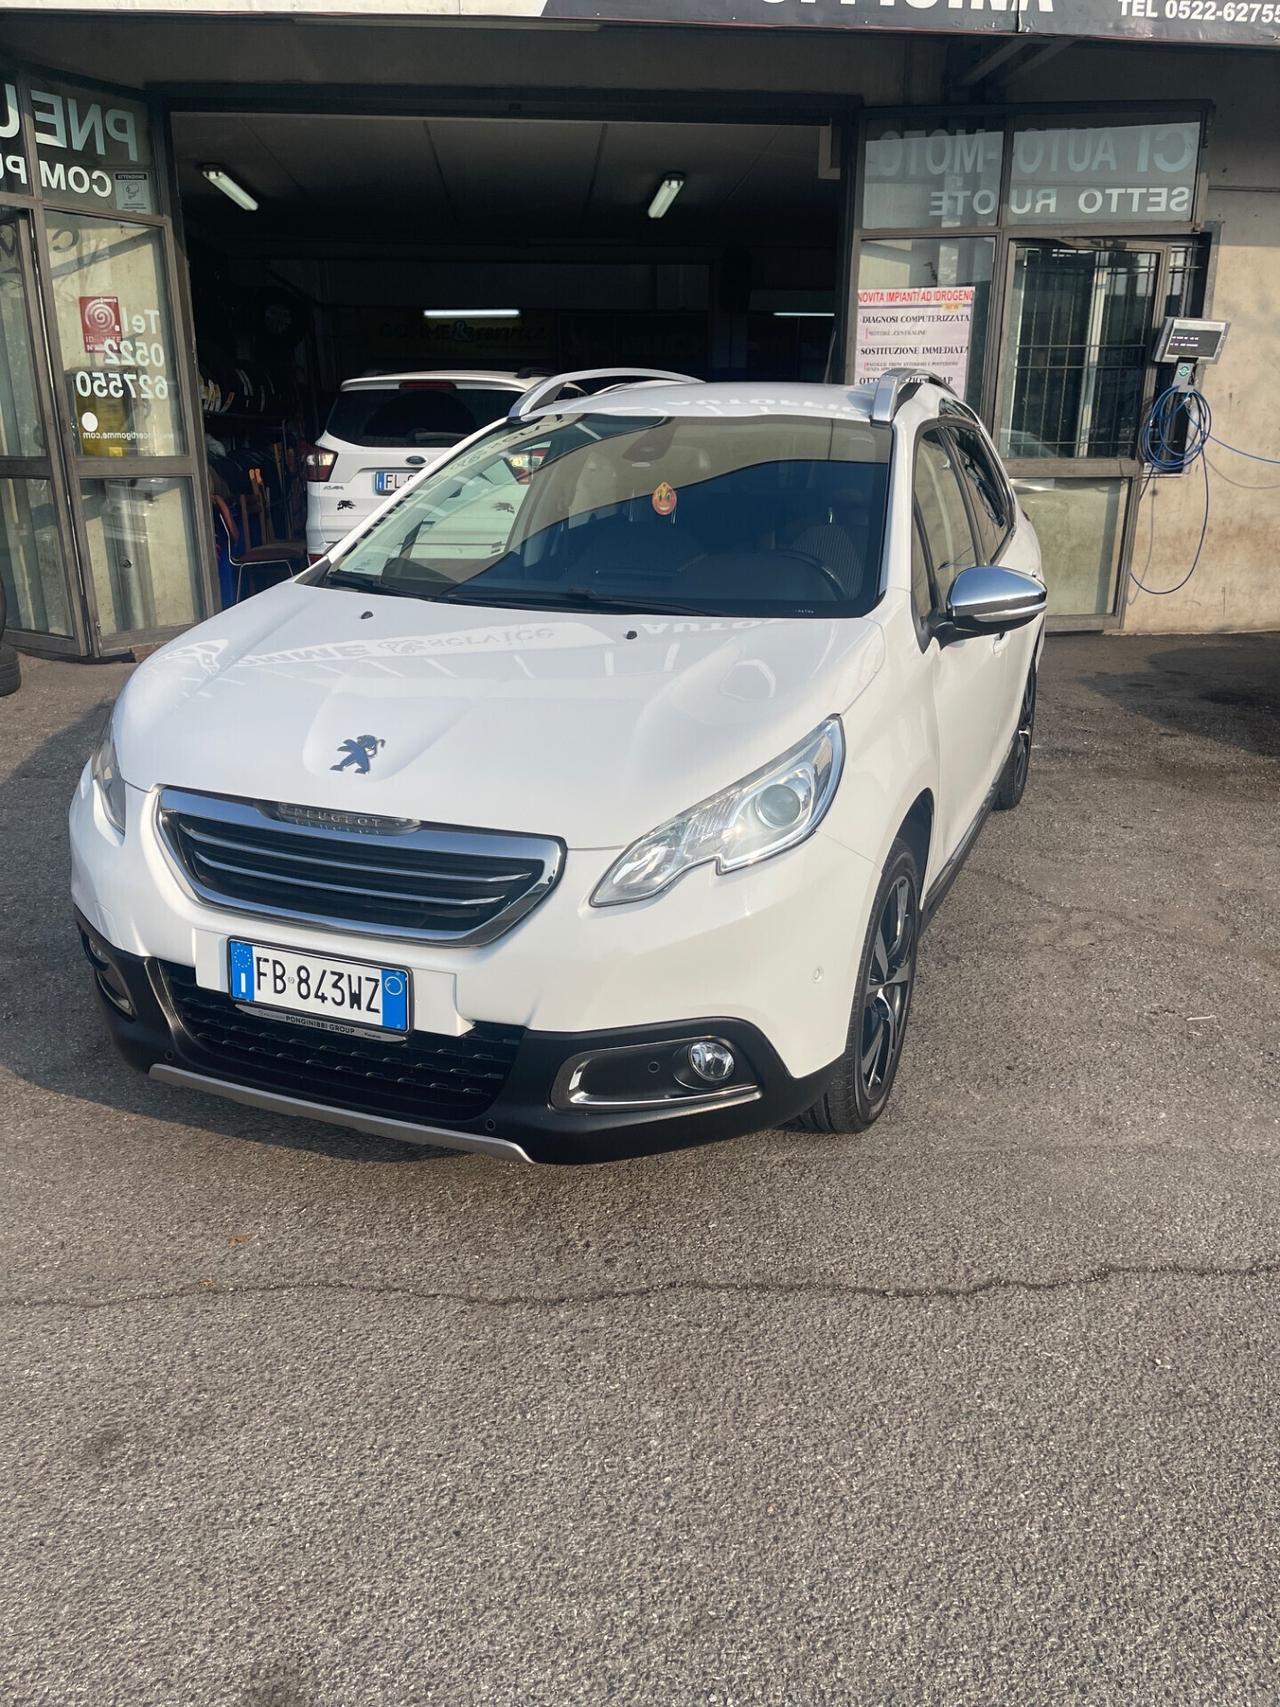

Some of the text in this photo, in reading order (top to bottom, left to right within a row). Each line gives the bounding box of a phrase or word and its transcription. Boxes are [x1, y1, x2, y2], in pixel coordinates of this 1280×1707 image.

[1118, 0, 1158, 18] TEL
[887, 291, 919, 302] IMPIANTI
[921, 290, 931, 302] AD
[862, 314, 970, 324] DIAGNOSI COMPUTERIZZATA
[860, 347, 919, 355] SOSTITUZIONE
[294, 807, 381, 827] PEUGEOT
[255, 956, 380, 1014] FB 843WZ
[285, 1015, 355, 1034] PONGINIBBI GROUP
